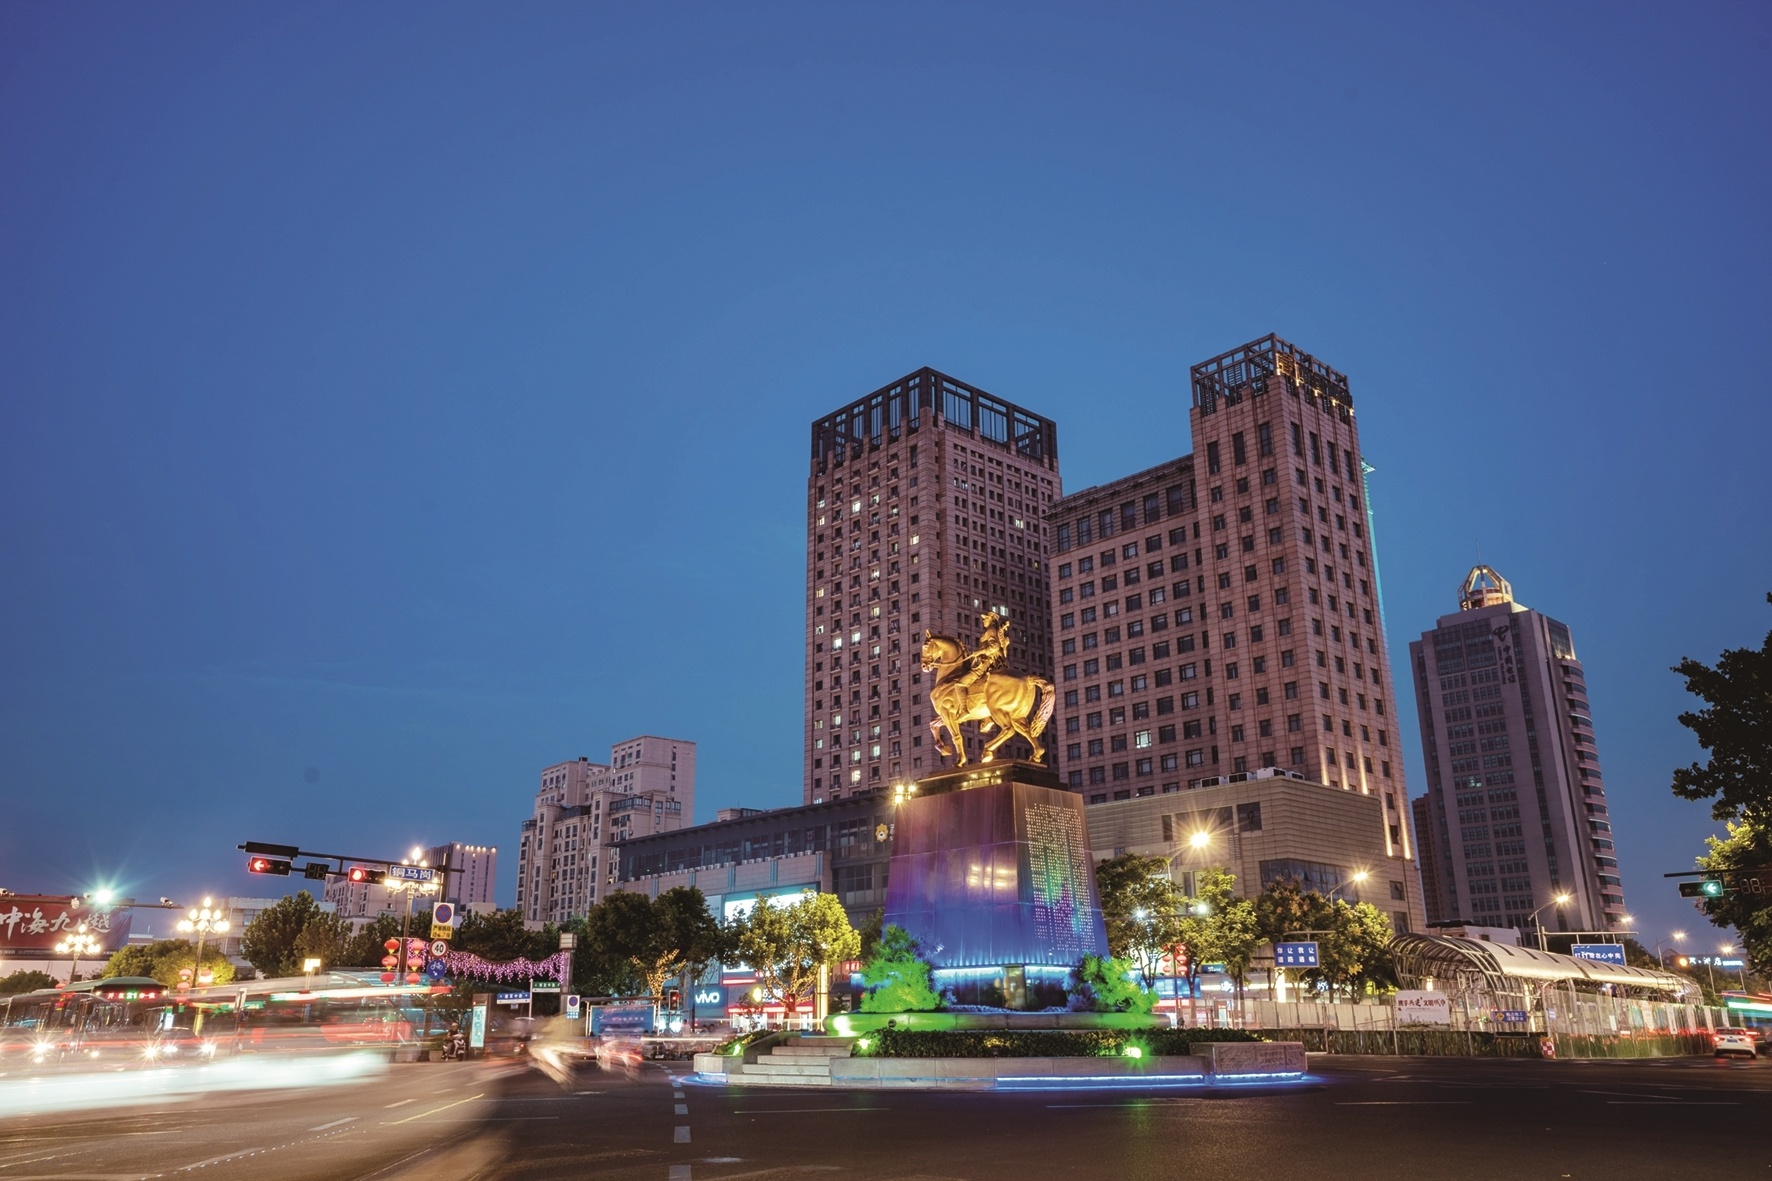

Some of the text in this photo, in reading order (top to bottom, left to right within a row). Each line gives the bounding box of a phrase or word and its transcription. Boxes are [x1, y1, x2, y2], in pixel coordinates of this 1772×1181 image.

[392, 867, 431, 880] 铜马岗
[434, 944, 444, 953] 40
[695, 989, 720, 1004] vivo
